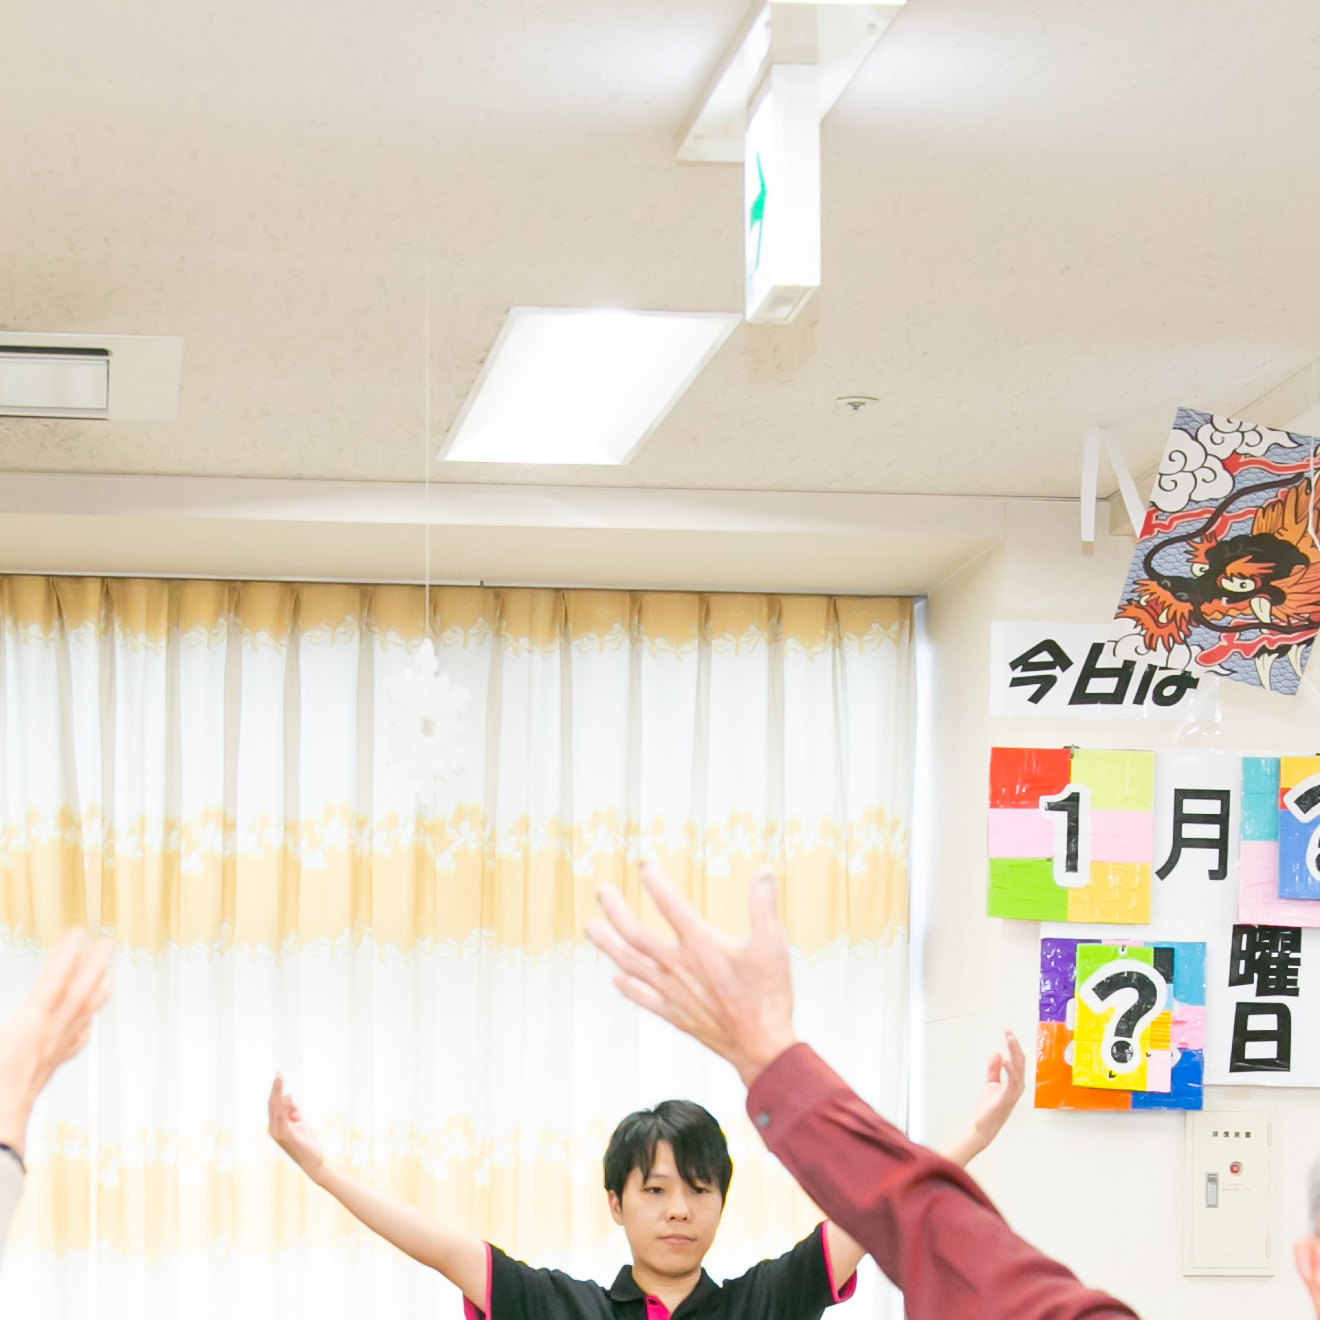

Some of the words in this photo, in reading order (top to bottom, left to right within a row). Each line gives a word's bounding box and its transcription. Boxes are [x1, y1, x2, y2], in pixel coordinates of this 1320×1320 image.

[1009, 638, 1200, 707] 今日は
[1228, 924, 1302, 1073] 曜日
